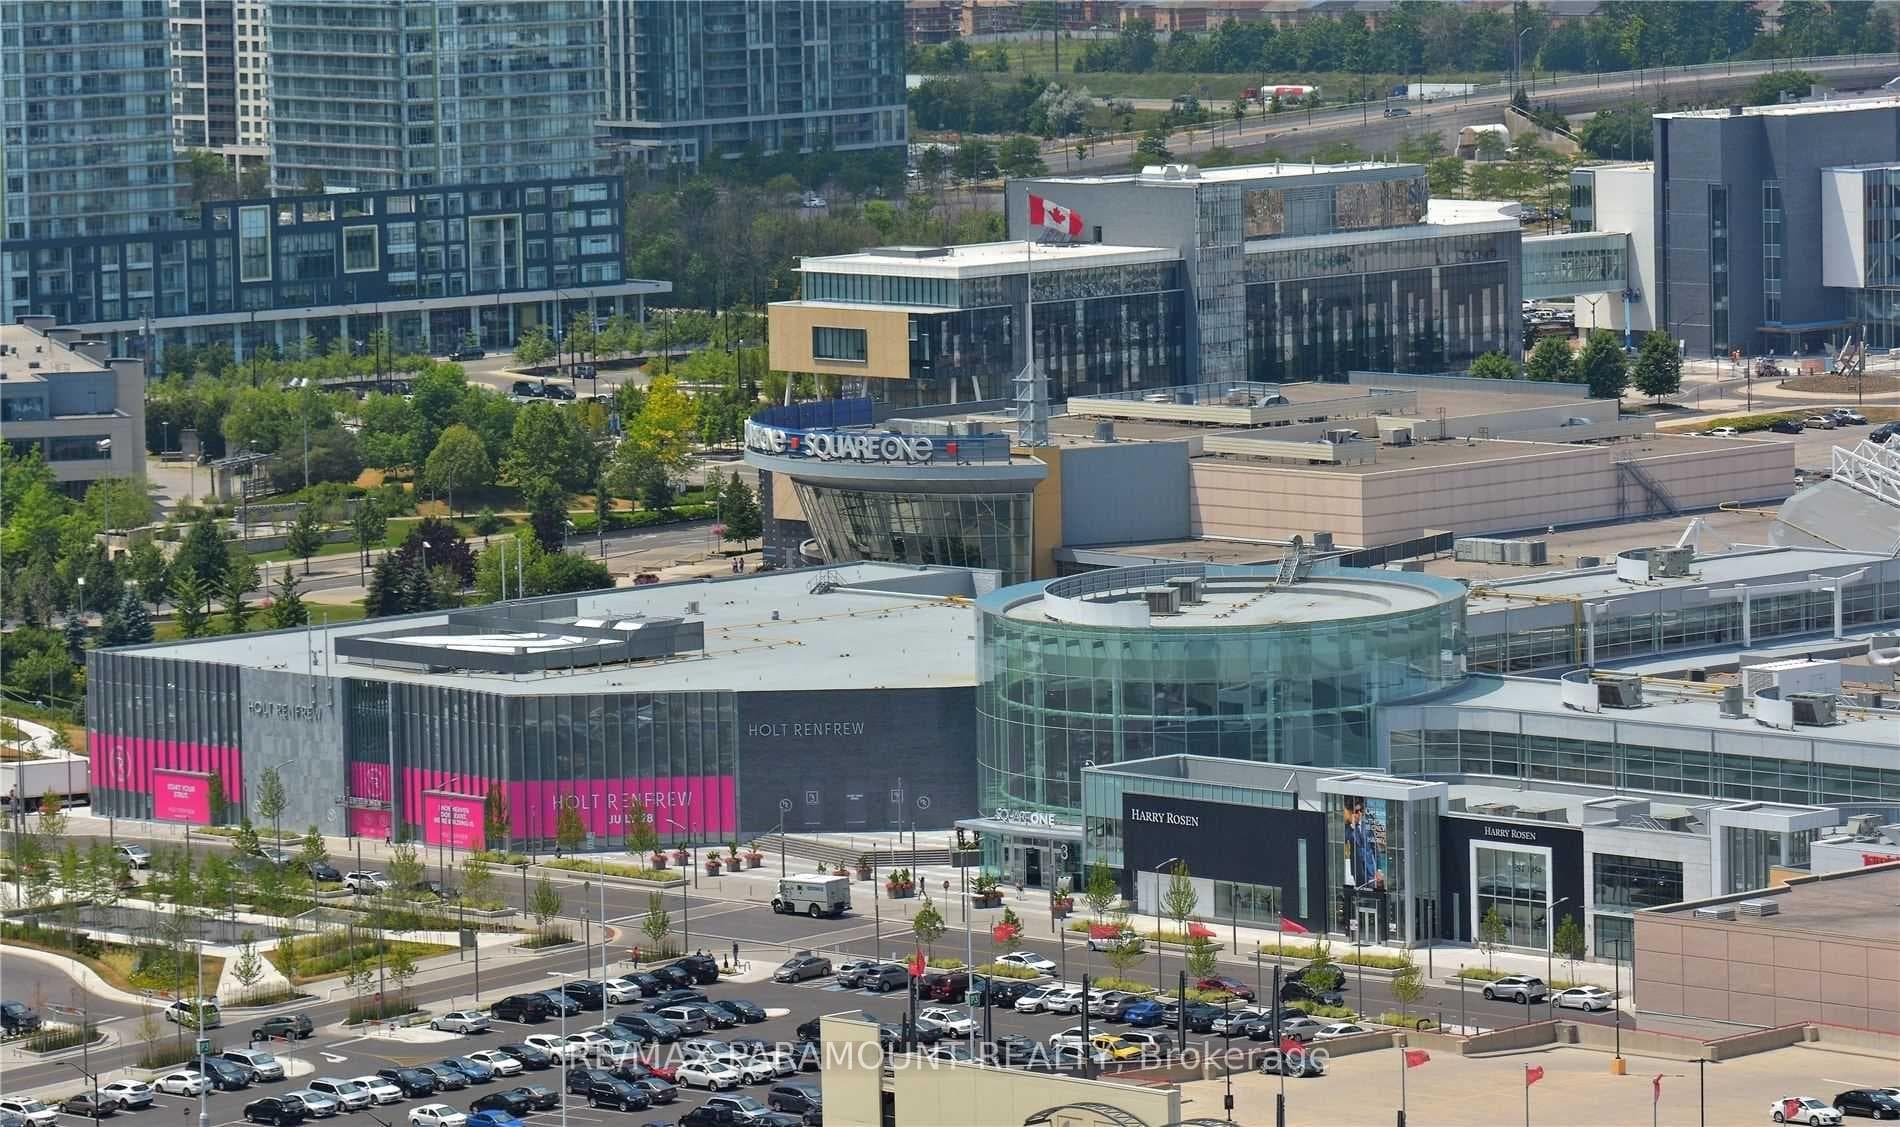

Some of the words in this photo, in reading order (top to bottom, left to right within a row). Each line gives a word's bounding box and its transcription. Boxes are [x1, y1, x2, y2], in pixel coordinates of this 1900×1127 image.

[805, 432, 880, 461] SQUARE
[248, 700, 273, 718] HOLT
[748, 723, 790, 736] HOLT
[793, 721, 865, 737] RENFREW
[552, 794, 600, 811] HOLT
[607, 791, 692, 811] RENFREW
[1030, 812, 1056, 826] ONE
[1131, 808, 1165, 823] HARRY
[1166, 812, 1199, 827] ROSEN
[1484, 826, 1510, 838] HARRY
[1511, 829, 1537, 841] ROSEN
[1060, 844, 1069, 860] 3
